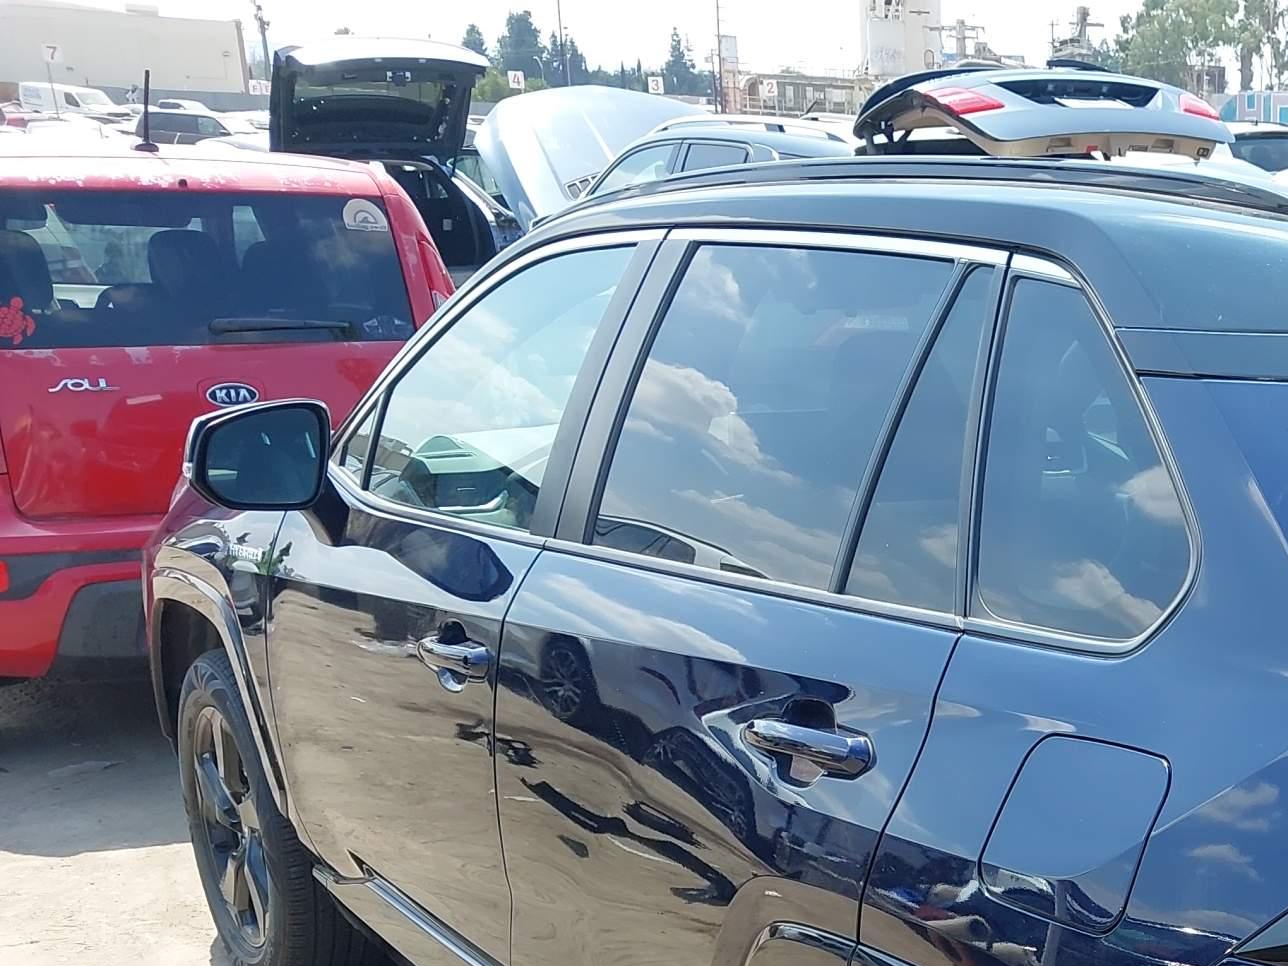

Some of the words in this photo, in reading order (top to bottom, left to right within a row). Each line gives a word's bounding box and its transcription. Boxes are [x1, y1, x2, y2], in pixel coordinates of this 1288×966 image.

[46, 45, 57, 60] 7
[511, 73, 521, 87] 4
[651, 79, 660, 92] 3
[766, 82, 776, 95] 2
[215, 388, 251, 402] KIA
